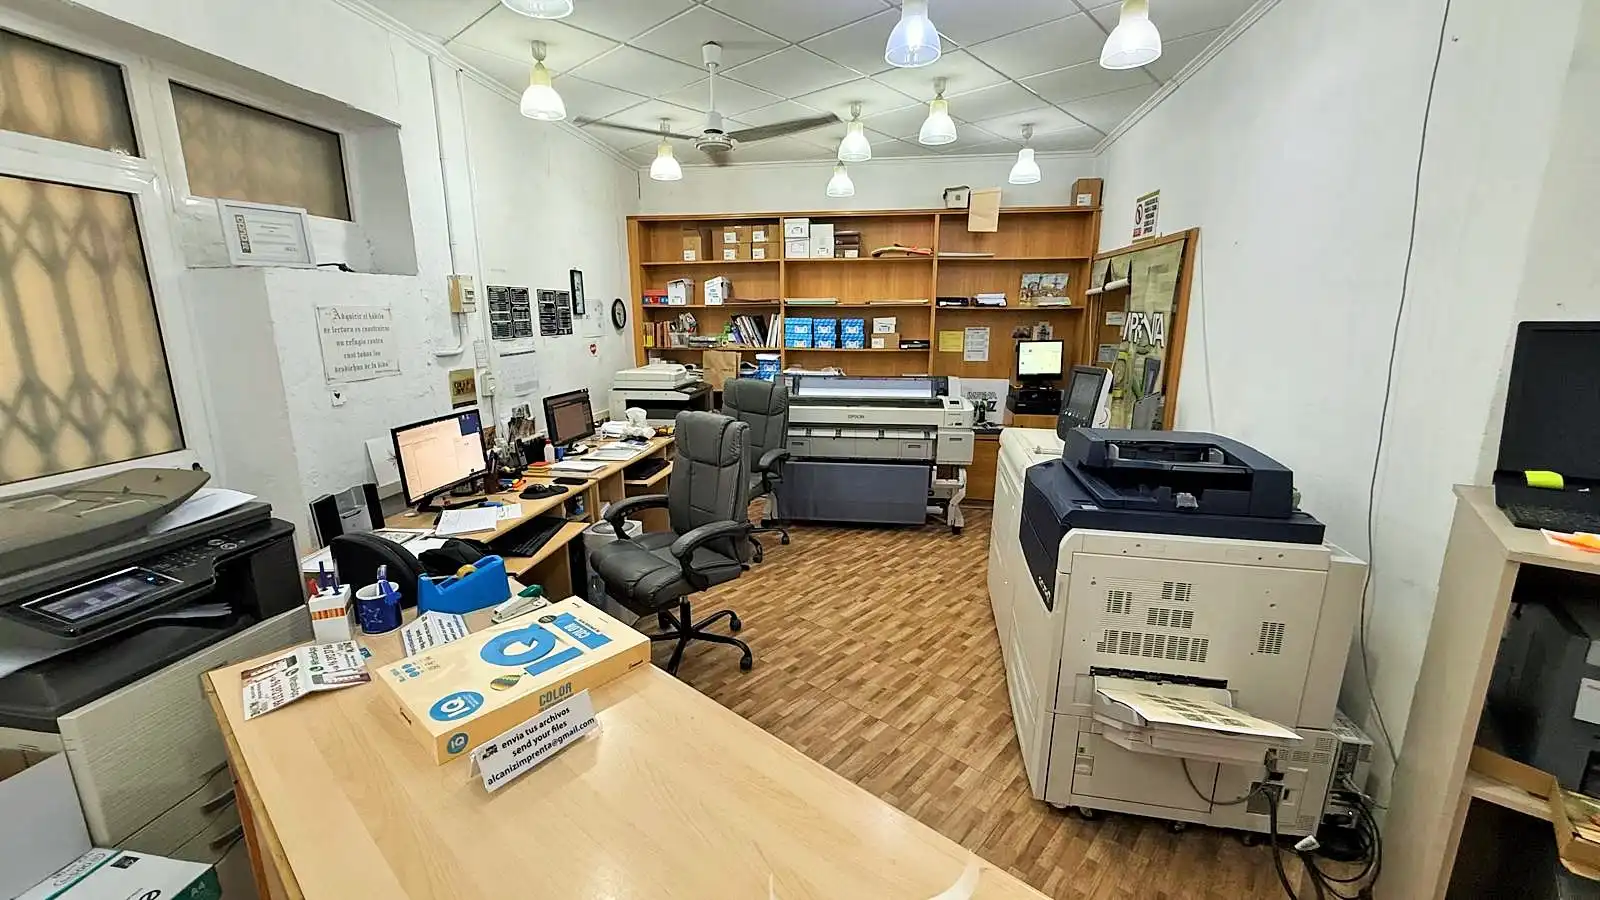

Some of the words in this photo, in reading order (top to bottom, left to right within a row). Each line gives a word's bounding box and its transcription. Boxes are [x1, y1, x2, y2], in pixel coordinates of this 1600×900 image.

[345, 337, 366, 347] refugio
[539, 682, 572, 706] COLOR
[451, 736, 465, 749] IQ
[501, 732, 525, 749] envia
[525, 724, 538, 736] tus
[539, 707, 570, 729] archivos
[512, 740, 532, 757] send
[533, 729, 551, 746] your
[551, 720, 568, 734] files
[487, 717, 595, 785] alcanizimprenta@gmail.com
